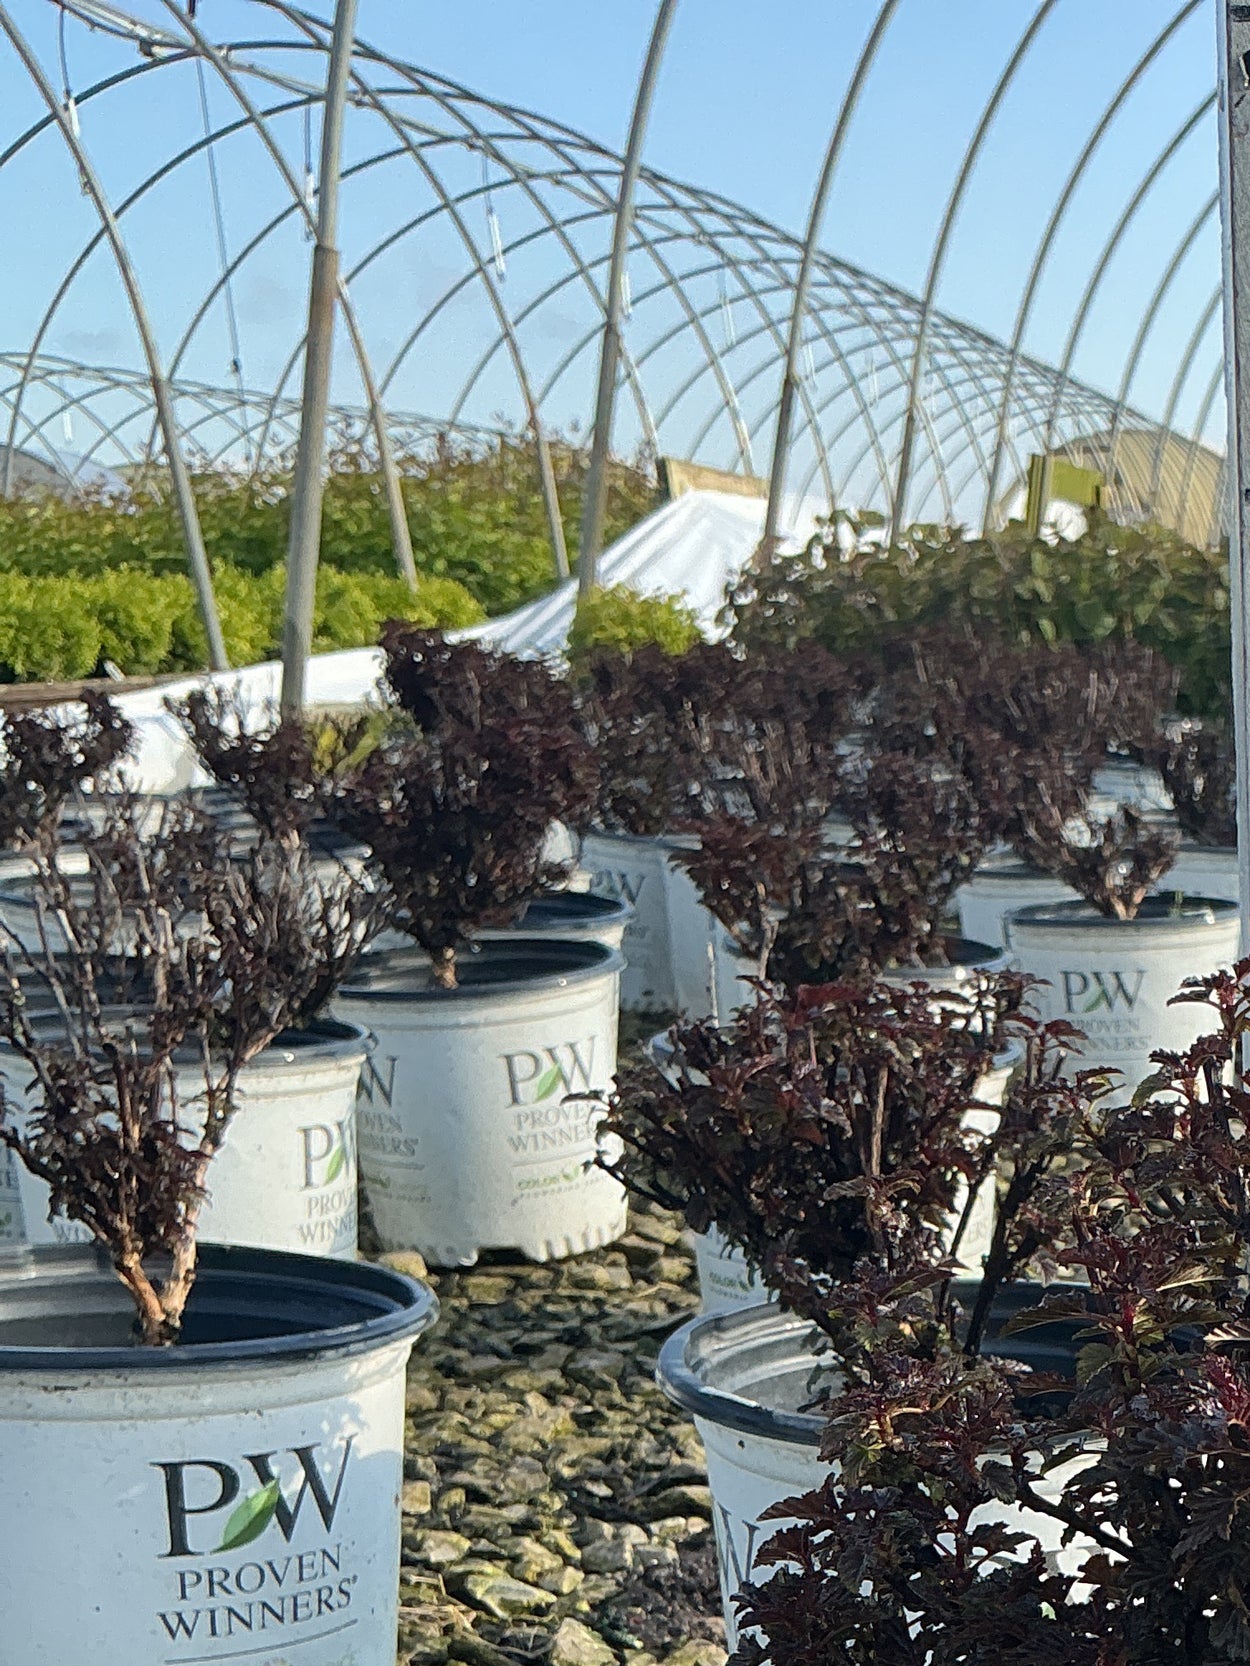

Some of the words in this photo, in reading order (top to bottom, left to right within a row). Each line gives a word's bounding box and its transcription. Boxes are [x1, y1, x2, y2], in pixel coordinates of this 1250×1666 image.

[1060, 968, 1147, 1015] PW
[497, 1035, 597, 1109] PW
[515, 1102, 592, 1131] PROVE
[149, 1432, 358, 1558] PW
[175, 1542, 342, 1601] PROVEN
